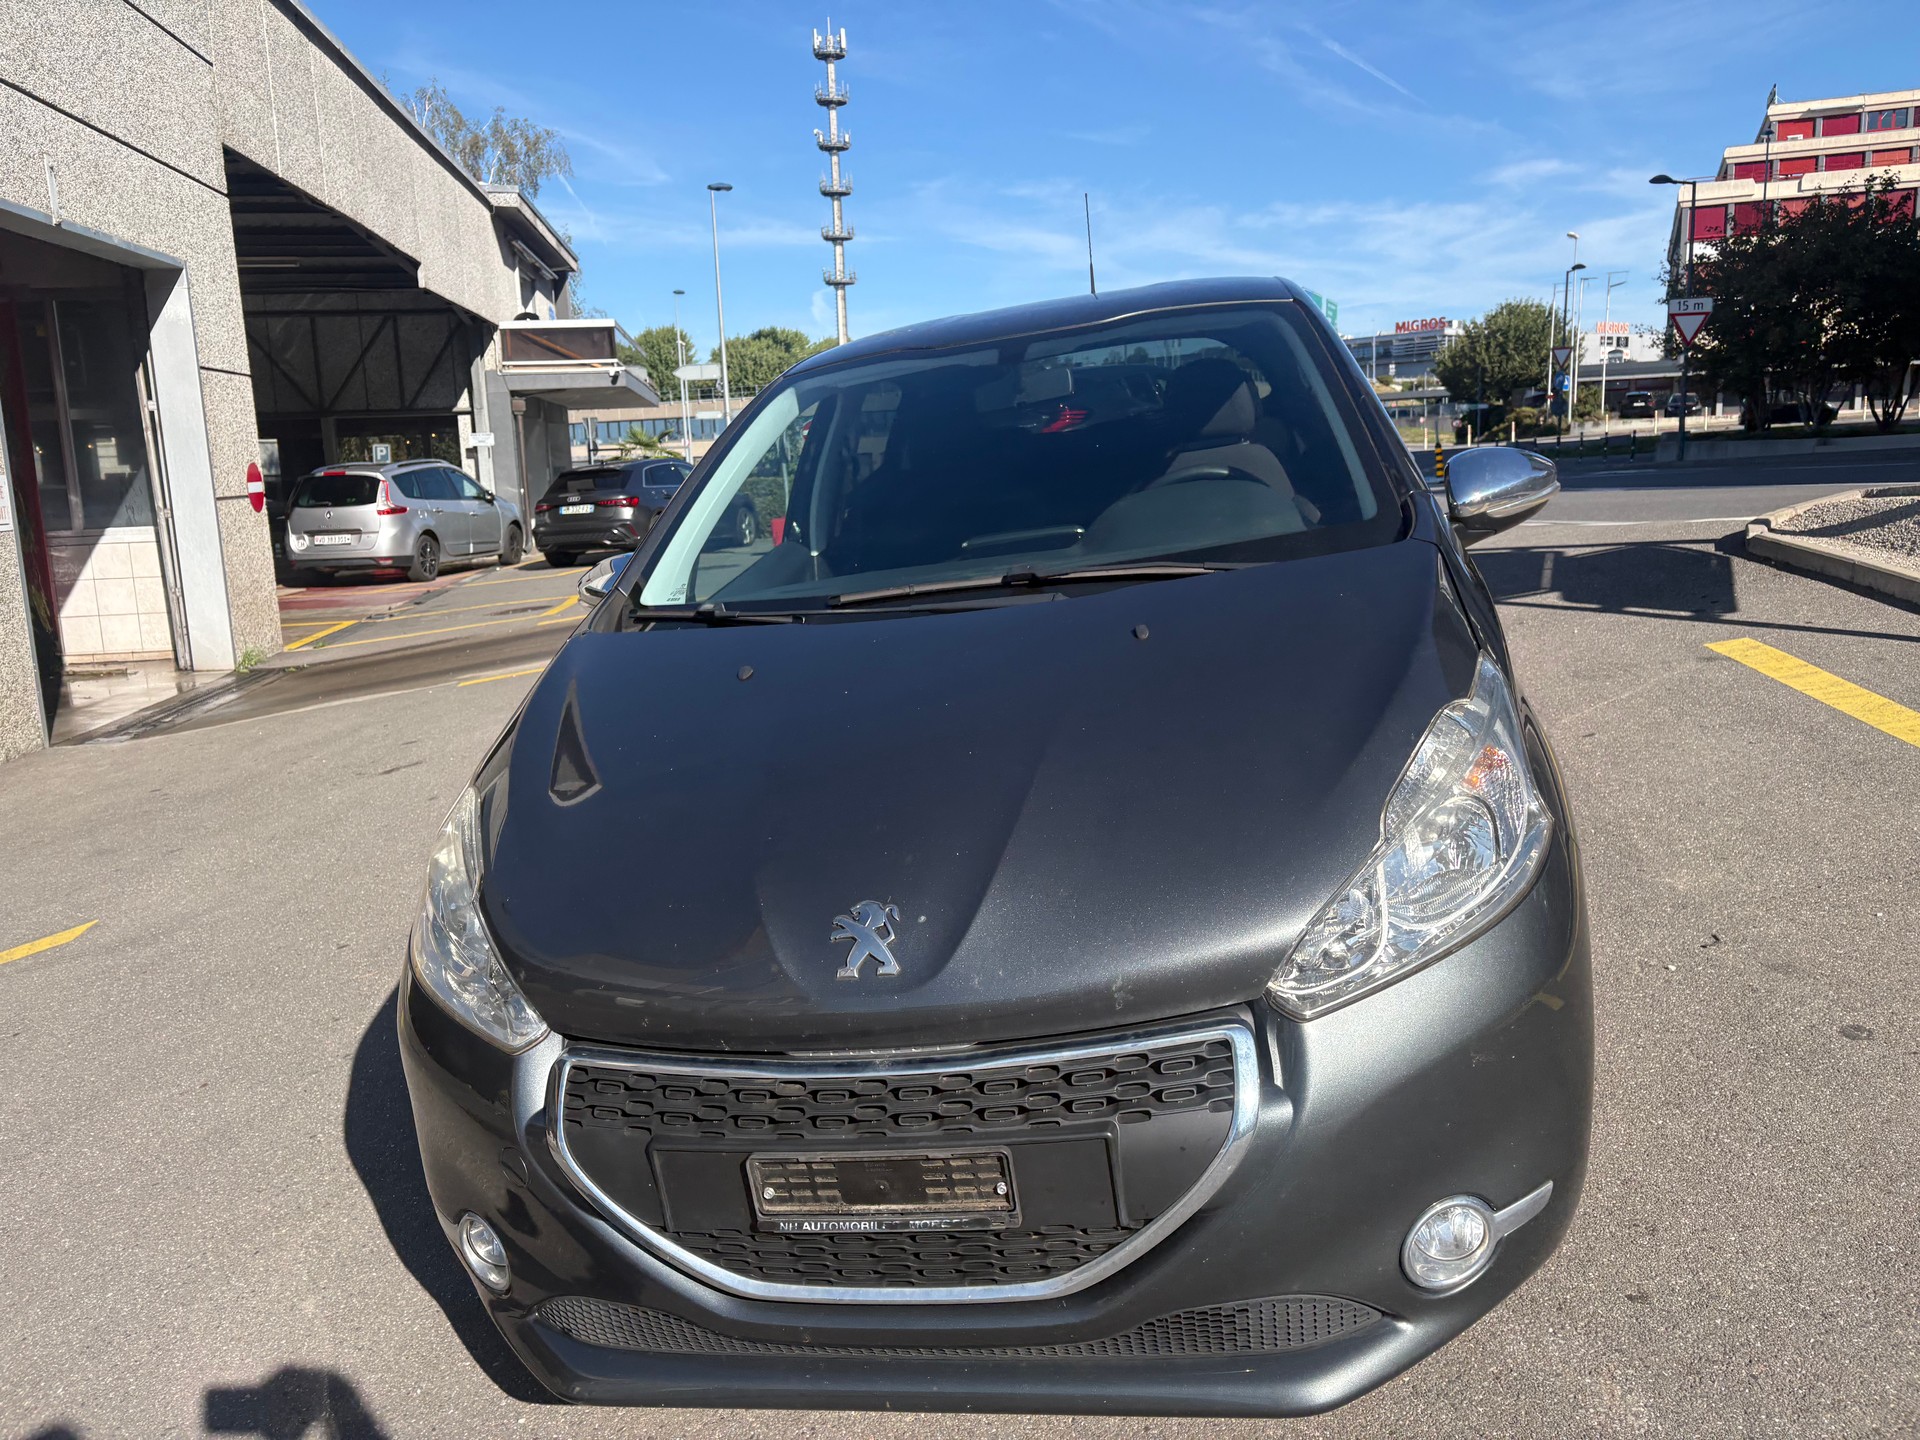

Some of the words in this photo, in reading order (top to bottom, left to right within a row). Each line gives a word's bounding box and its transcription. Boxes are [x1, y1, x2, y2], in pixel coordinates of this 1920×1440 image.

[1677, 300, 1689, 312] 15
[1693, 302, 1704, 311] m
[1395, 316, 1446, 334] MIGROS
[1596, 321, 1630, 334] MIGROS
[377, 447, 387, 460] P
